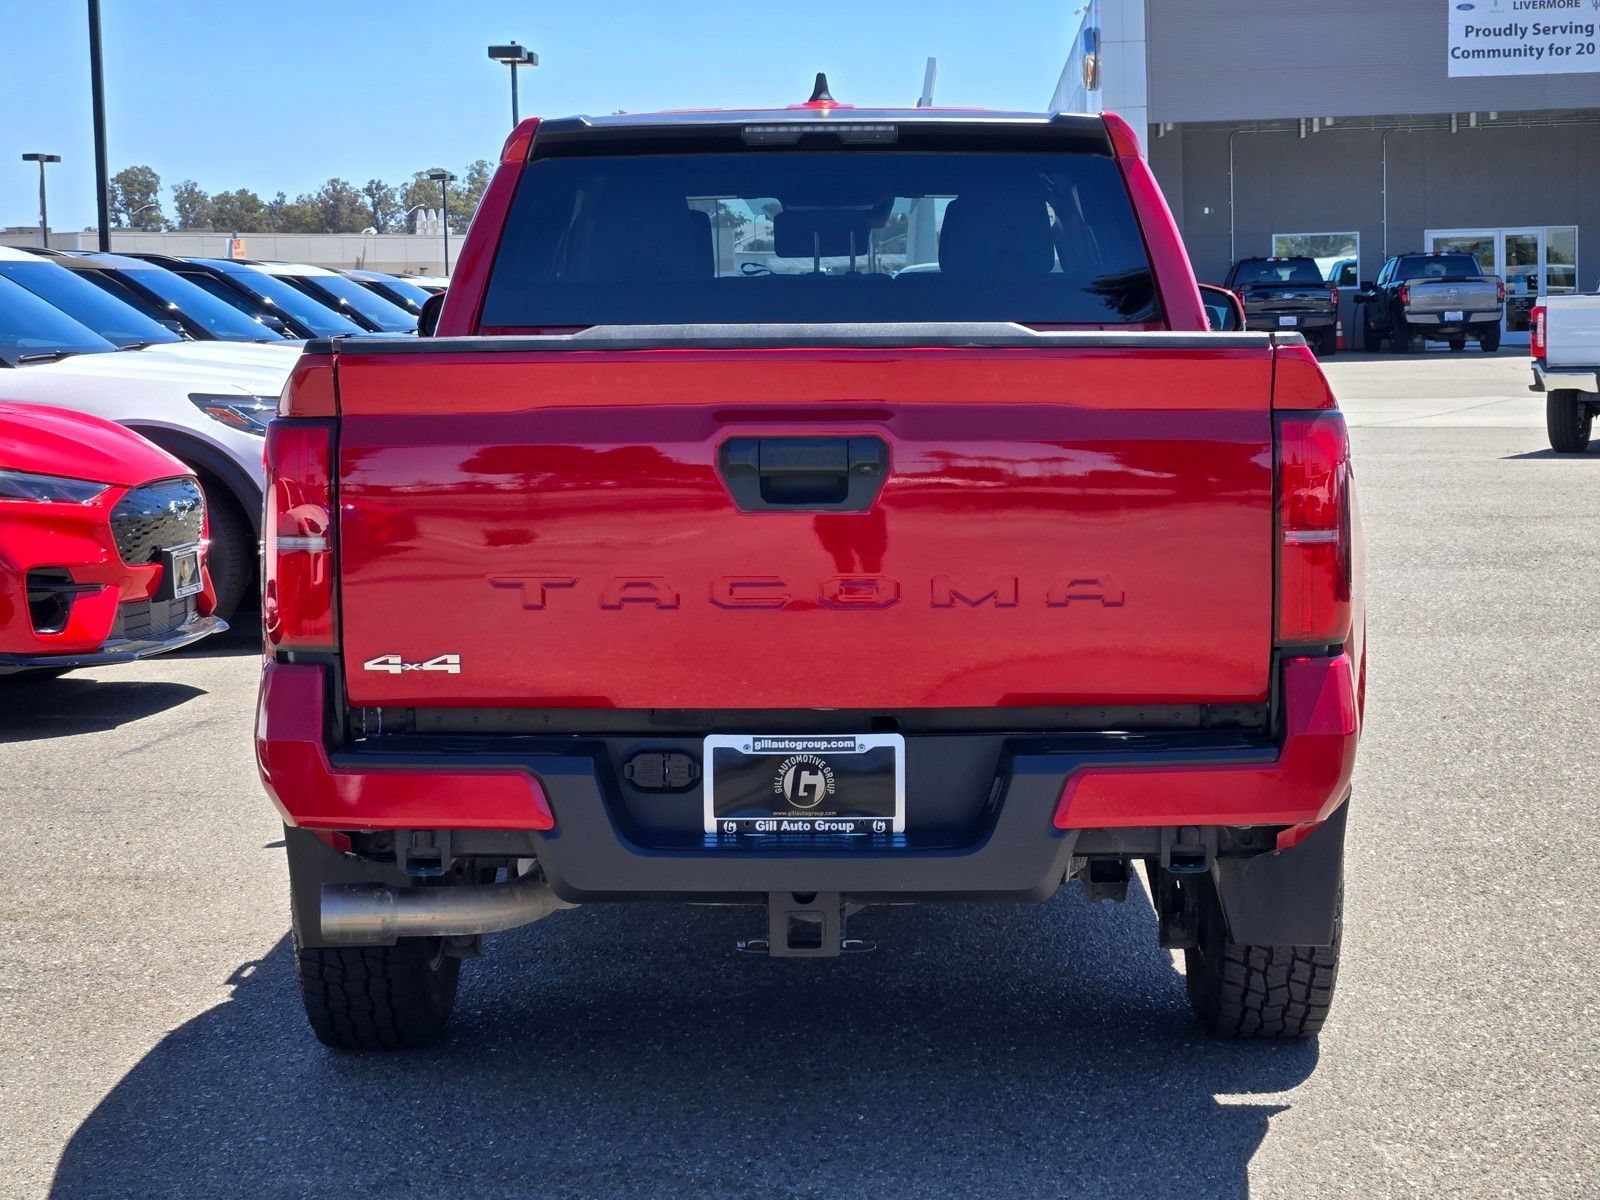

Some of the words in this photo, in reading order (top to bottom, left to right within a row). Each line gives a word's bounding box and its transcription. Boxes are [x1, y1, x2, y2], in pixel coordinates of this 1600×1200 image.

[1513, 0, 1581, 10] LIVERMORE
[1464, 23, 1528, 39] Proudly
[1532, 21, 1595, 37] Serving
[1450, 44, 1544, 60] Community
[1548, 43, 1572, 56] for
[1575, 42, 1596, 55] 20
[489, 574, 1125, 610] TACOMA
[363, 654, 461, 675] 4x4
[754, 739, 855, 750] gillautogroup.com
[777, 754, 827, 775] AUTOMOTIVE
[773, 776, 783, 794] GILL
[823, 766, 836, 794] GROUP
[755, 820, 777, 831] Gill
[781, 820, 811, 831] Auto
[814, 820, 855, 833] Group
